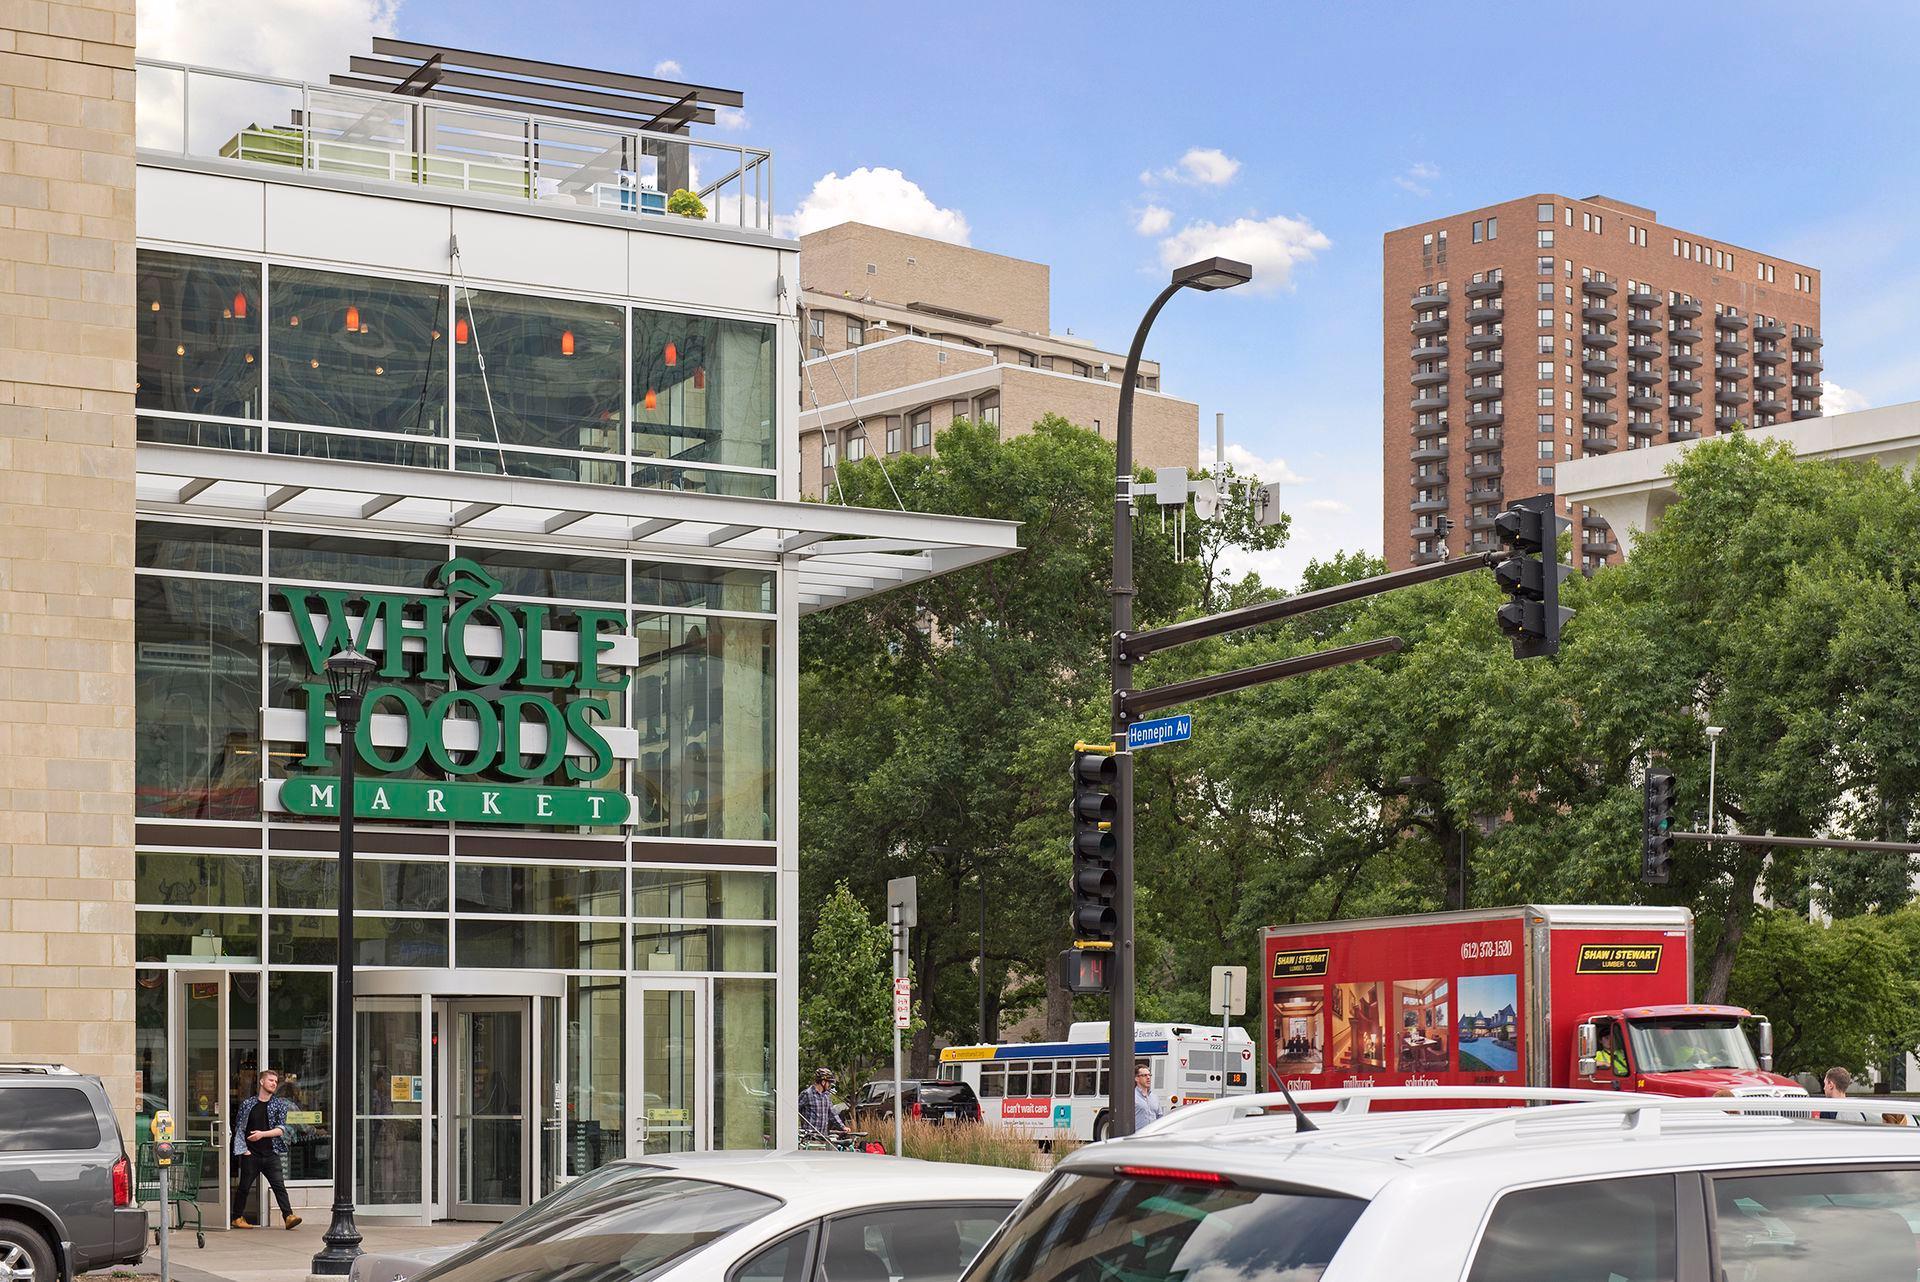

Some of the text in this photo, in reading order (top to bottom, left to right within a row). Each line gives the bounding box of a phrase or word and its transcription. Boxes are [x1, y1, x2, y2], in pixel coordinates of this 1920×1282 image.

[279, 577, 631, 692] WHOLE
[300, 683, 614, 782] FOODS
[1131, 720, 1188, 743] Hennepin Av
[310, 784, 605, 819] MARKET
[1461, 940, 1512, 960] (612) 378-1520
[1584, 950, 1609, 960] SHAW
[1615, 950, 1657, 960] STEWART
[1287, 1077, 1312, 1091] custom
